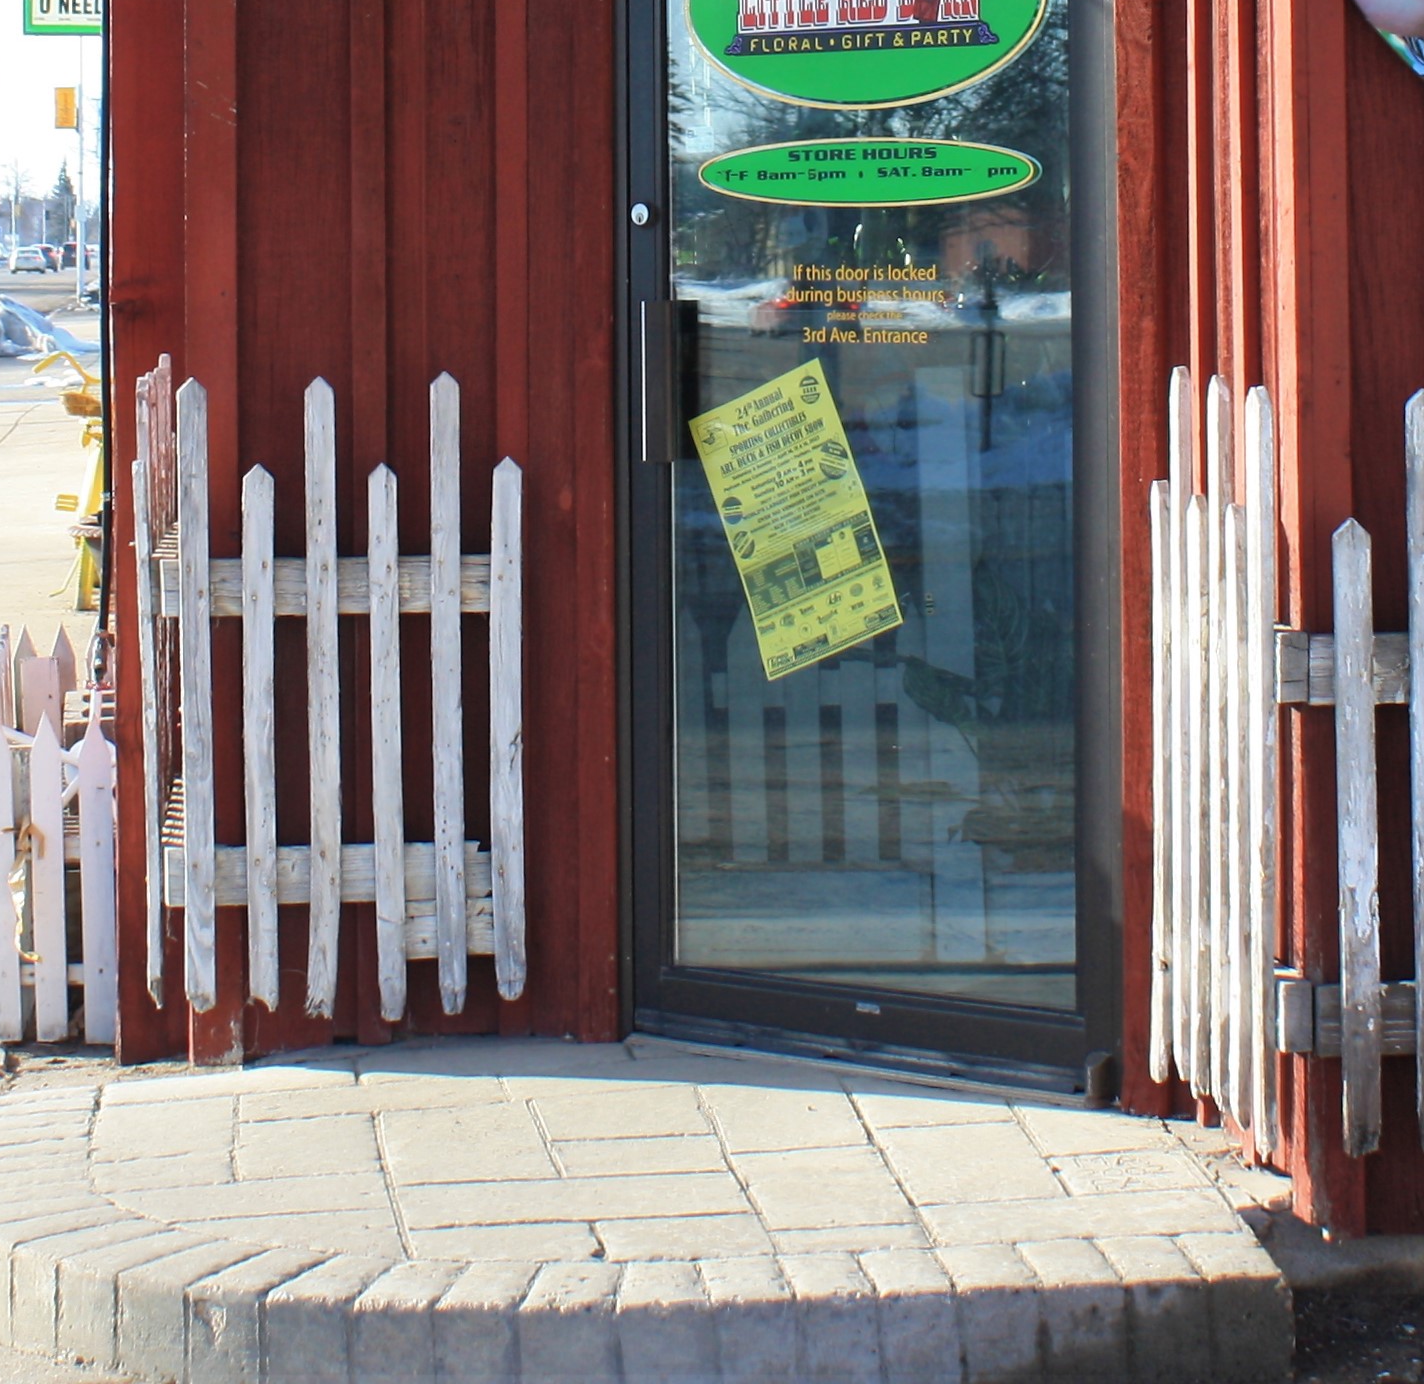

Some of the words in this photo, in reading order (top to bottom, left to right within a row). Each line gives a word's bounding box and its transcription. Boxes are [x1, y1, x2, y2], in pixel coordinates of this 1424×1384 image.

[749, 35, 824, 53] FLORAL
[841, 31, 886, 49] GIFT
[892, 32, 905, 47] &
[910, 28, 974, 47] PARTY
[788, 149, 856, 162] STORE
[862, 146, 937, 160] HOURS
[877, 167, 917, 178] SAT.
[793, 264, 803, 281] If
[806, 265, 832, 281] this
[835, 265, 870, 281] door
[873, 265, 884, 281] is
[888, 265, 937, 281] locked
[786, 286, 833, 306] during
[836, 287, 899, 303] business
[827, 310, 856, 322] please
[858, 310, 887, 320] check
[802, 327, 826, 343] 3rd
[829, 327, 860, 343] Ave.
[863, 327, 928, 344] Entrance
[752, 387, 782, 410] Annual
[733, 420, 749, 436] The
[751, 397, 794, 428] Gathering
